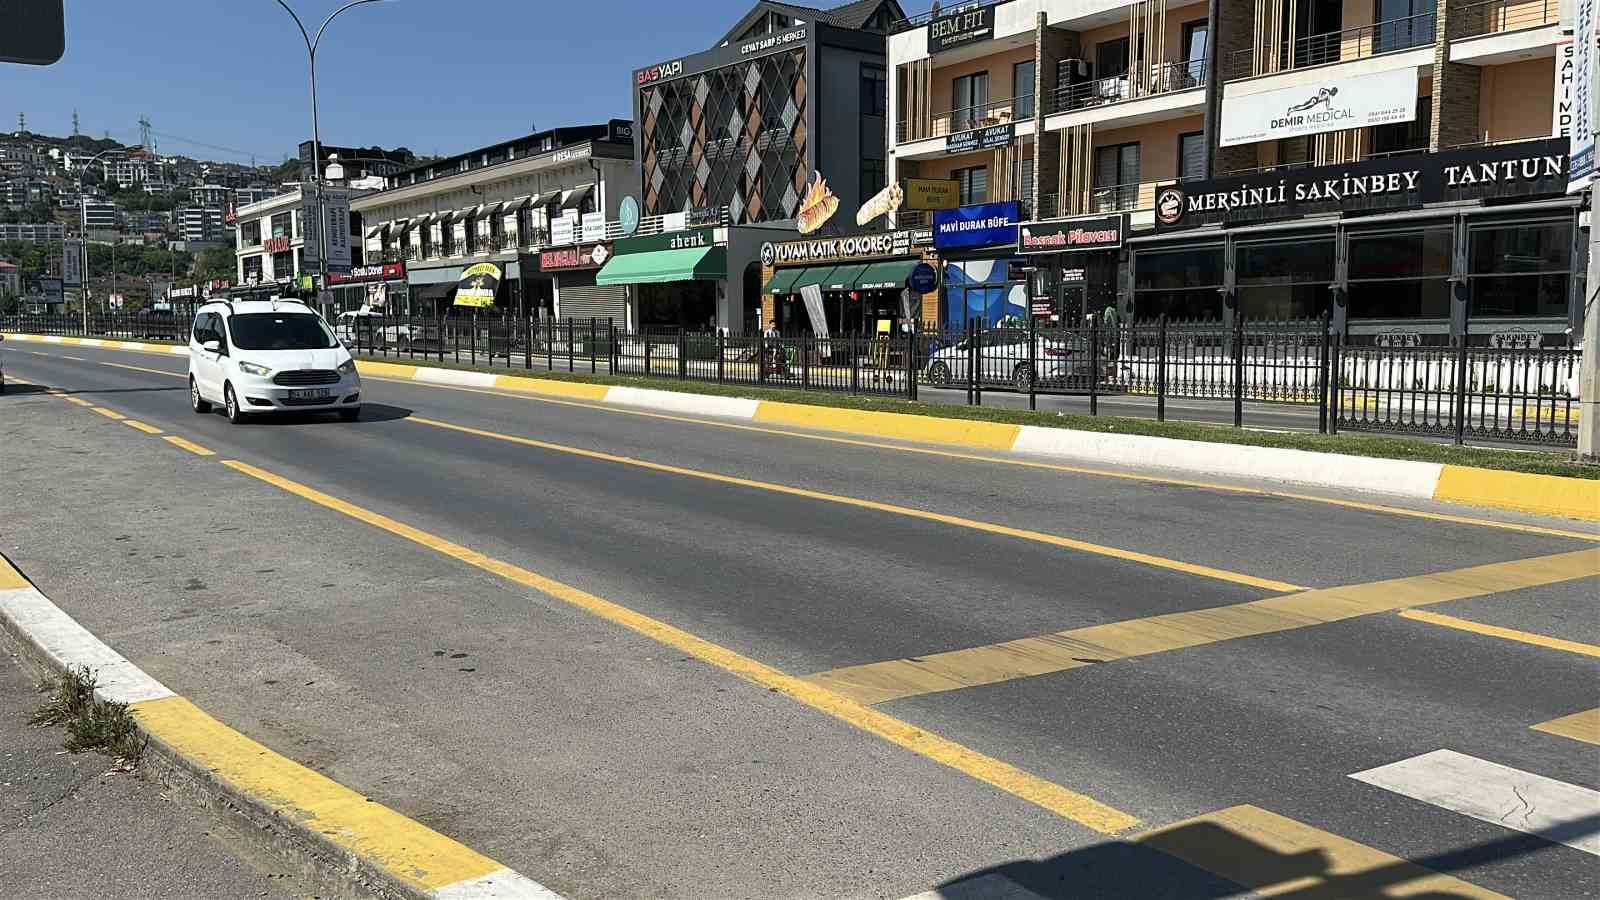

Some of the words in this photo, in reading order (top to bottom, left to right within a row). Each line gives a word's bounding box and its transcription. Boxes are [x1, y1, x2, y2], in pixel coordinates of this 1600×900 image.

[931, 17, 960, 39] BEM
[963, 9, 985, 30] FIT
[741, 41, 760, 54] CEVAT
[760, 37, 776, 50] SARP
[1270, 115, 1304, 129] DEMIR
[1306, 107, 1355, 124] MEDICAL
[951, 132, 974, 142] AVUKAT
[985, 125, 1009, 136] AVUKAT
[1444, 153, 1572, 186] TANTUN
[1187, 181, 1287, 214] MERSİNLİ
[1294, 170, 1420, 201] SAKİNBEY
[940, 220, 959, 233] MAVİ
[959, 219, 986, 231] DURAK
[987, 216, 1009, 228] BÜFE
[670, 231, 705, 249] ahenk
[774, 243, 808, 260] YUVAM
[810, 241, 837, 258] KATIK
